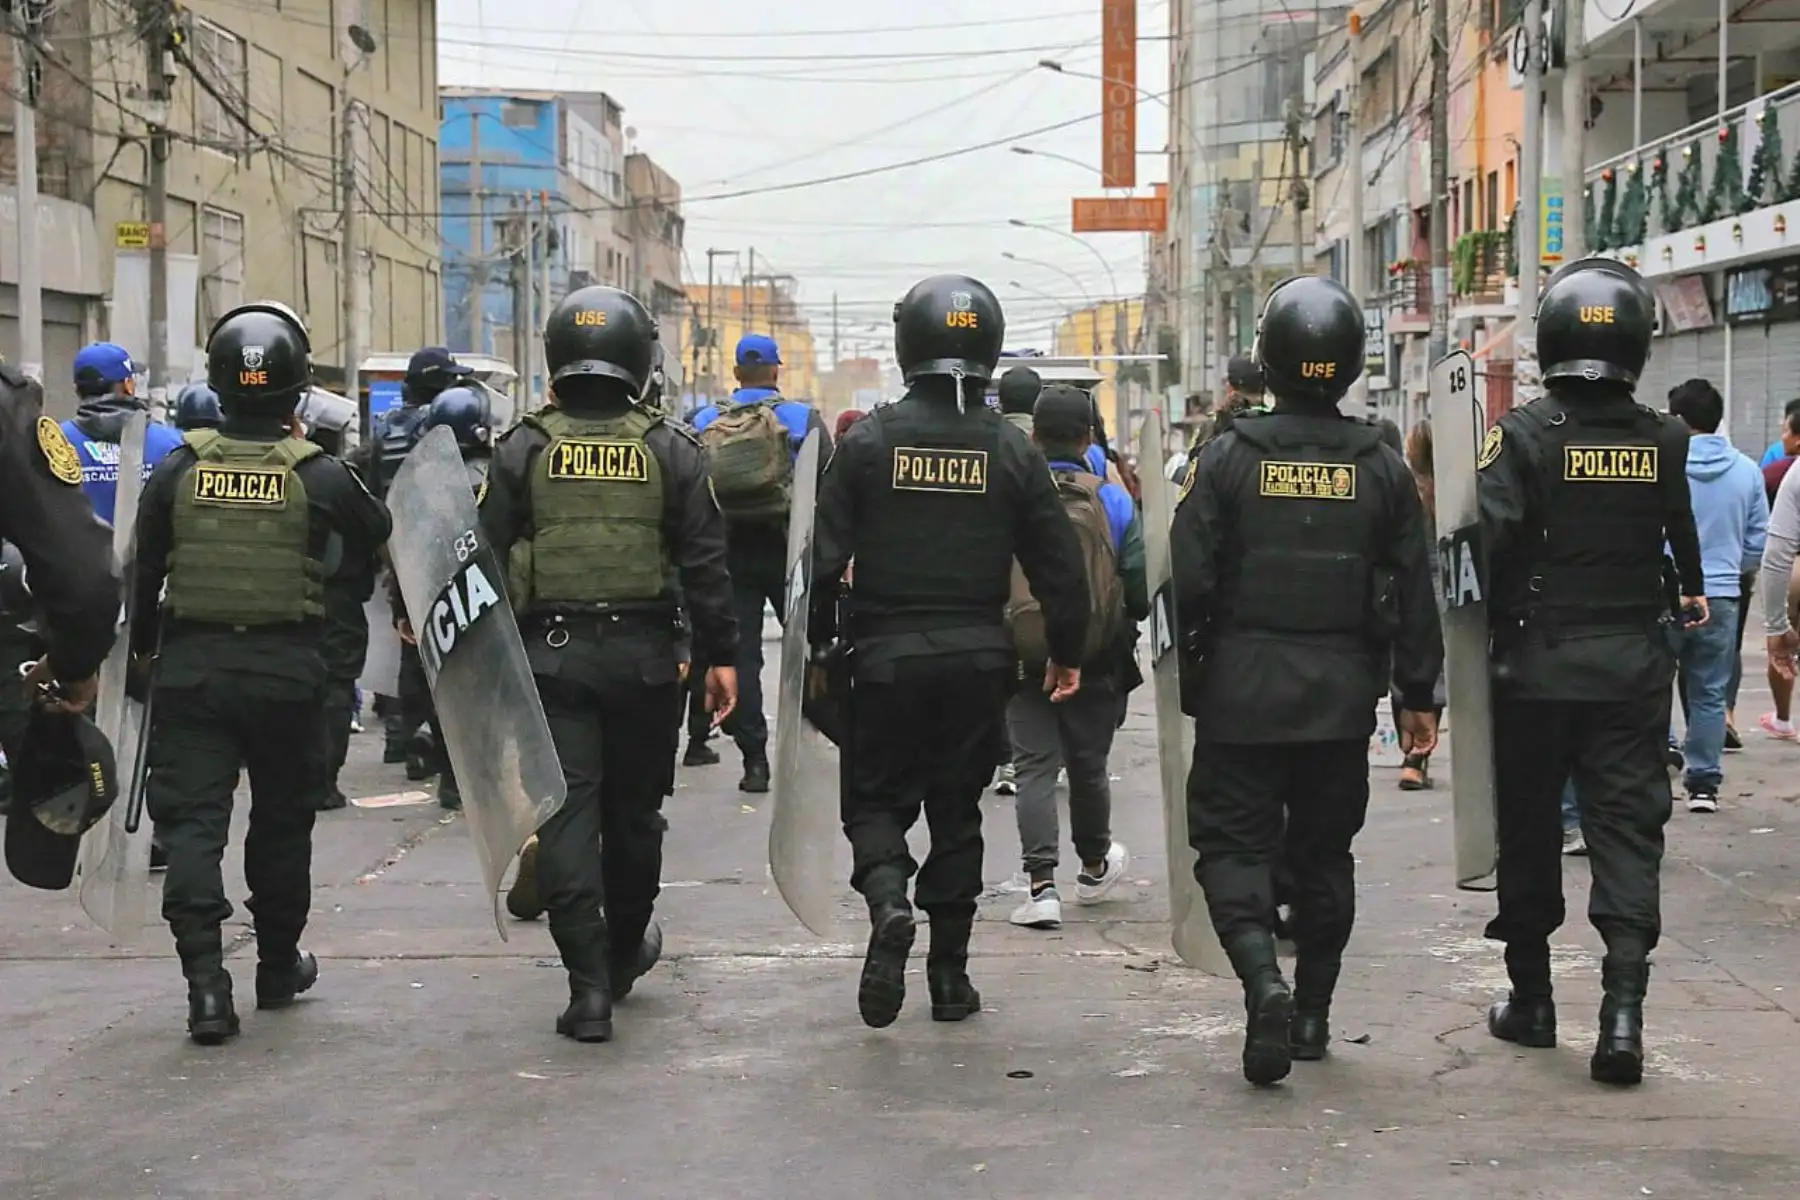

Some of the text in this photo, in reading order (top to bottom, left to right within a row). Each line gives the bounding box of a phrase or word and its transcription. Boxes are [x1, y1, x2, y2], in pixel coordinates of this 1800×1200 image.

[1108, 64, 1132, 179] TORRE
[574, 311, 607, 326] USE
[946, 311, 978, 328] USE
[1580, 306, 1614, 323] USE
[239, 371, 267, 385] USE
[1301, 362, 1336, 378] USE
[560, 444, 640, 477] POLICIA
[897, 454, 982, 484] POLICIA
[1570, 450, 1653, 477] POLICIA
[200, 471, 279, 499] POLICIA
[1266, 465, 1332, 484] POLICIA
[454, 529, 478, 562] 83
